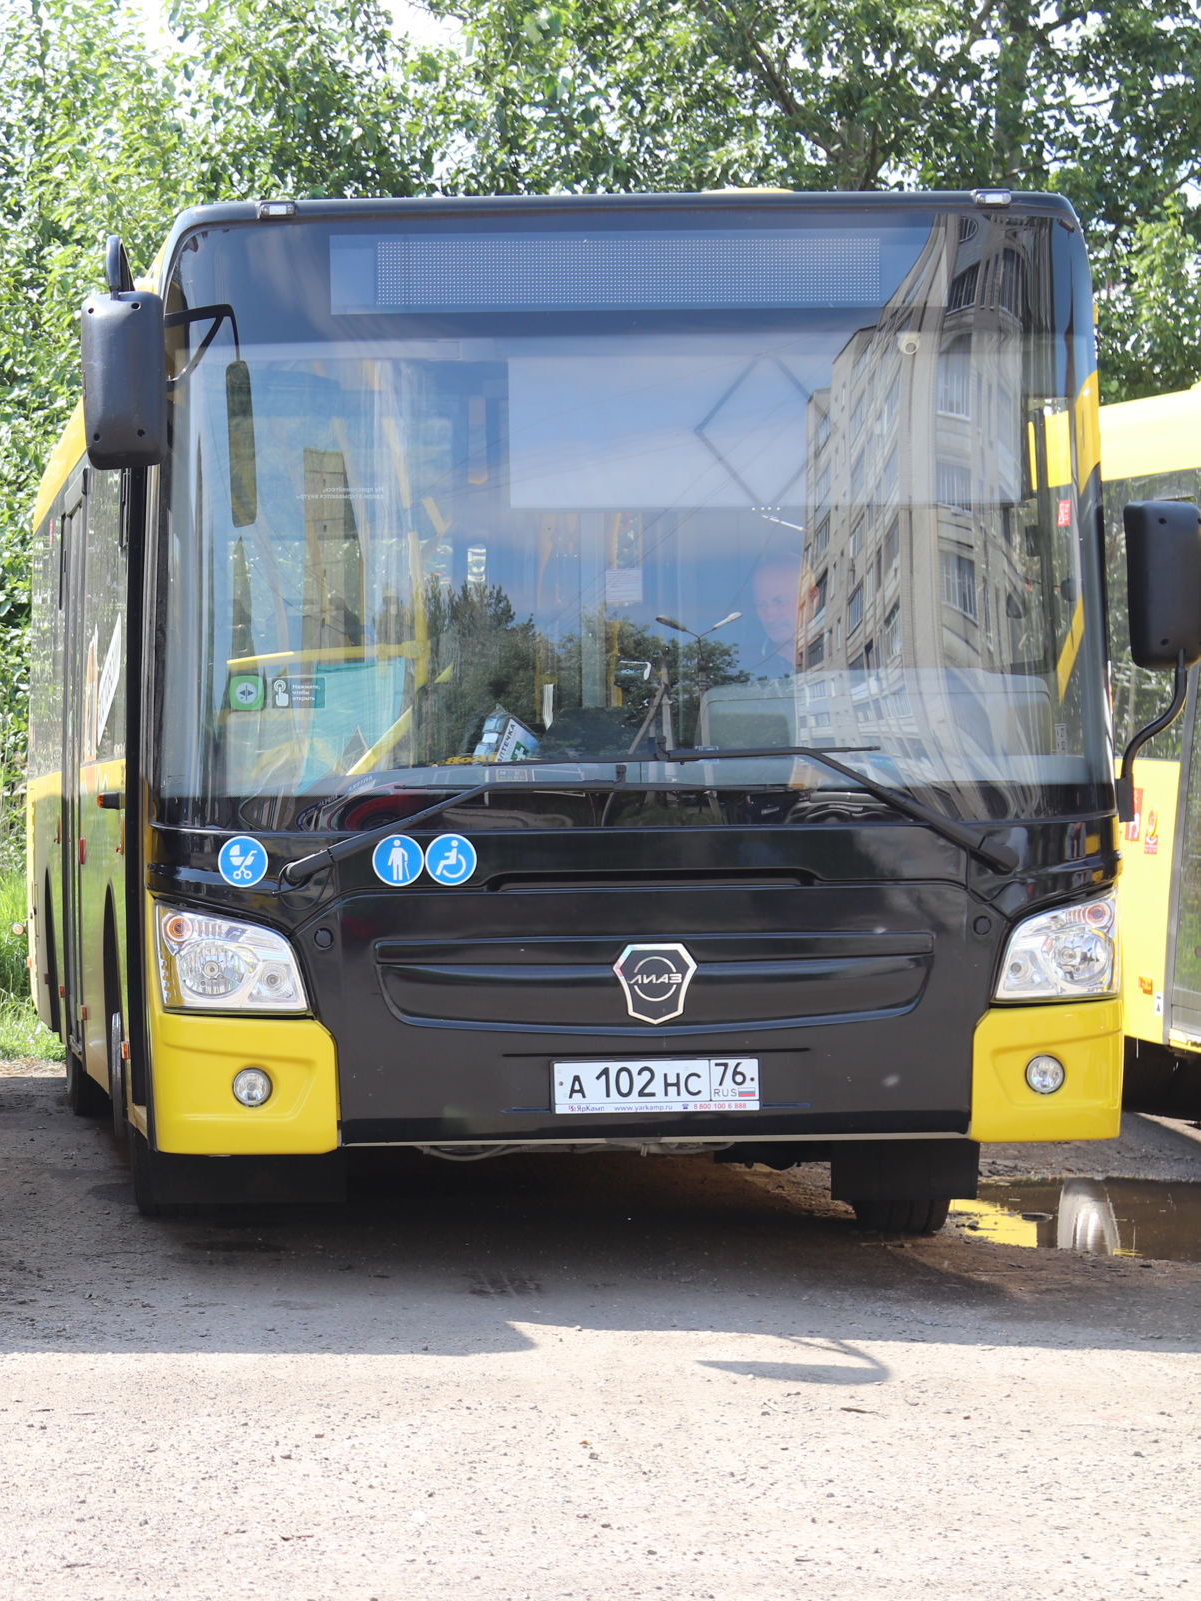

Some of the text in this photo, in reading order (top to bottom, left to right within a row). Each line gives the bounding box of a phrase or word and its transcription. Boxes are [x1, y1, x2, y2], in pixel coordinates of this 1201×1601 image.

[714, 1062, 747, 1087] 76
[713, 1088, 737, 1097] RUS
[614, 1104, 673, 1112] www.yarkamp.ru
